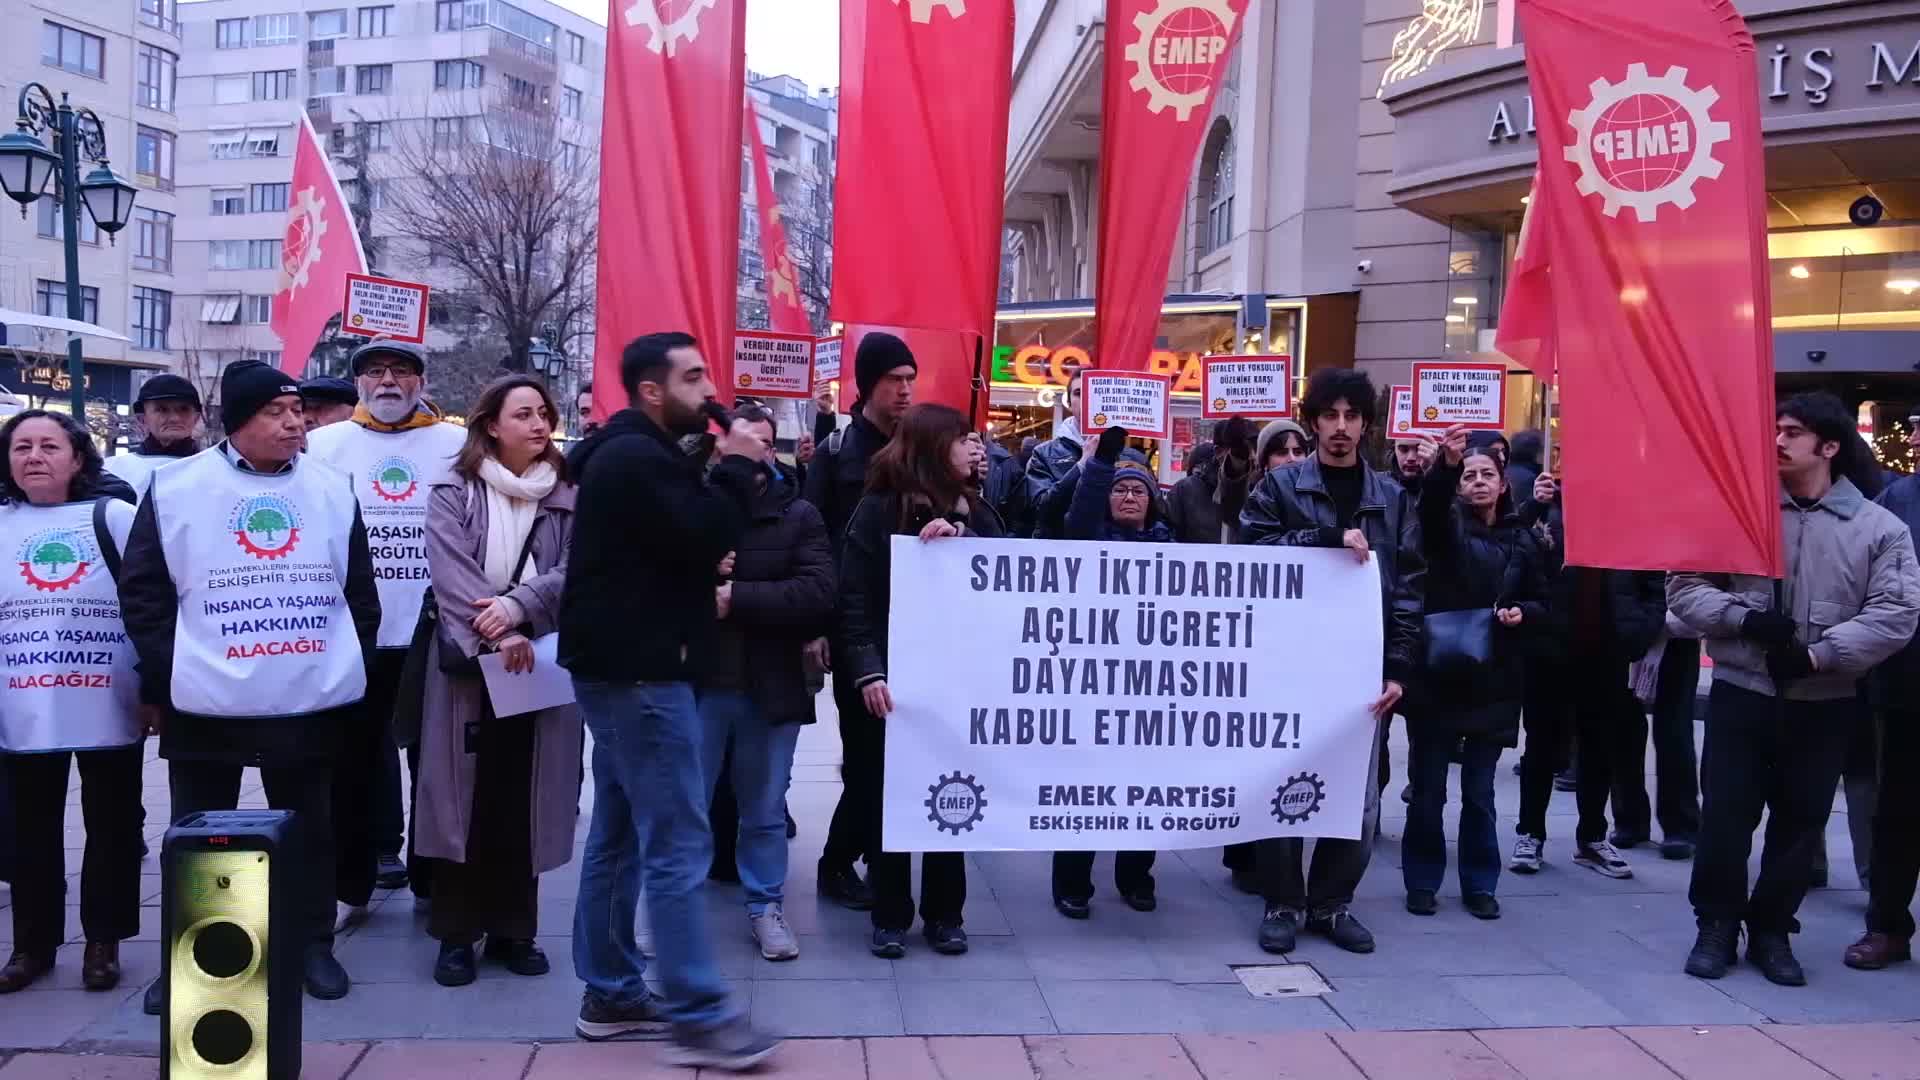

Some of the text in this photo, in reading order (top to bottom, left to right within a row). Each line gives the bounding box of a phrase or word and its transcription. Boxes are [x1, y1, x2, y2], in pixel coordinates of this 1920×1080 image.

[1153, 36, 1227, 65] EMEP
[1769, 43, 1833, 104] İŞ
[743, 339, 775, 351] VERGİDE
[776, 342, 803, 352] ADALET
[760, 364, 785, 375] ÜCRET!
[1209, 364, 1235, 373] SEFALET
[1237, 364, 1246, 372] VE
[1420, 371, 1449, 380] SEFALET
[1451, 372, 1460, 380] VE
[1432, 383, 1466, 393] DÜZENİNE
[369, 543, 428, 560] RGÜTL
[209, 568, 230, 577] TÜM
[232, 563, 290, 574] EMEKLİLERİN
[970, 550, 1304, 600] SARAY İKTİDARININ
[208, 571, 335, 589] ESKİŞEHİR ŞUBESİ
[203, 595, 337, 616] İNSANCA YAŞAMAK
[221, 615, 328, 636] HAKKIMIZ!
[1022, 601, 1254, 656] AÇLIK ÜCRETİ
[0, 629, 126, 646] NSANCA YAŞAMAK
[226, 636, 327, 660] ALACAĞIZ!
[6, 650, 113, 667] HAKKIMIZ!
[8, 670, 112, 689] ALACAĞIZ!
[1012, 657, 1248, 698] DAYATMASINI
[969, 702, 1301, 749] KABUL ETMİYORUZ!
[939, 796, 975, 811] EMEP
[1038, 785, 1117, 806] EMEK
[1283, 790, 1315, 806] EMEP
[1029, 811, 1240, 834] ESKİŞEHİR İL ÖRGÜTÜ
